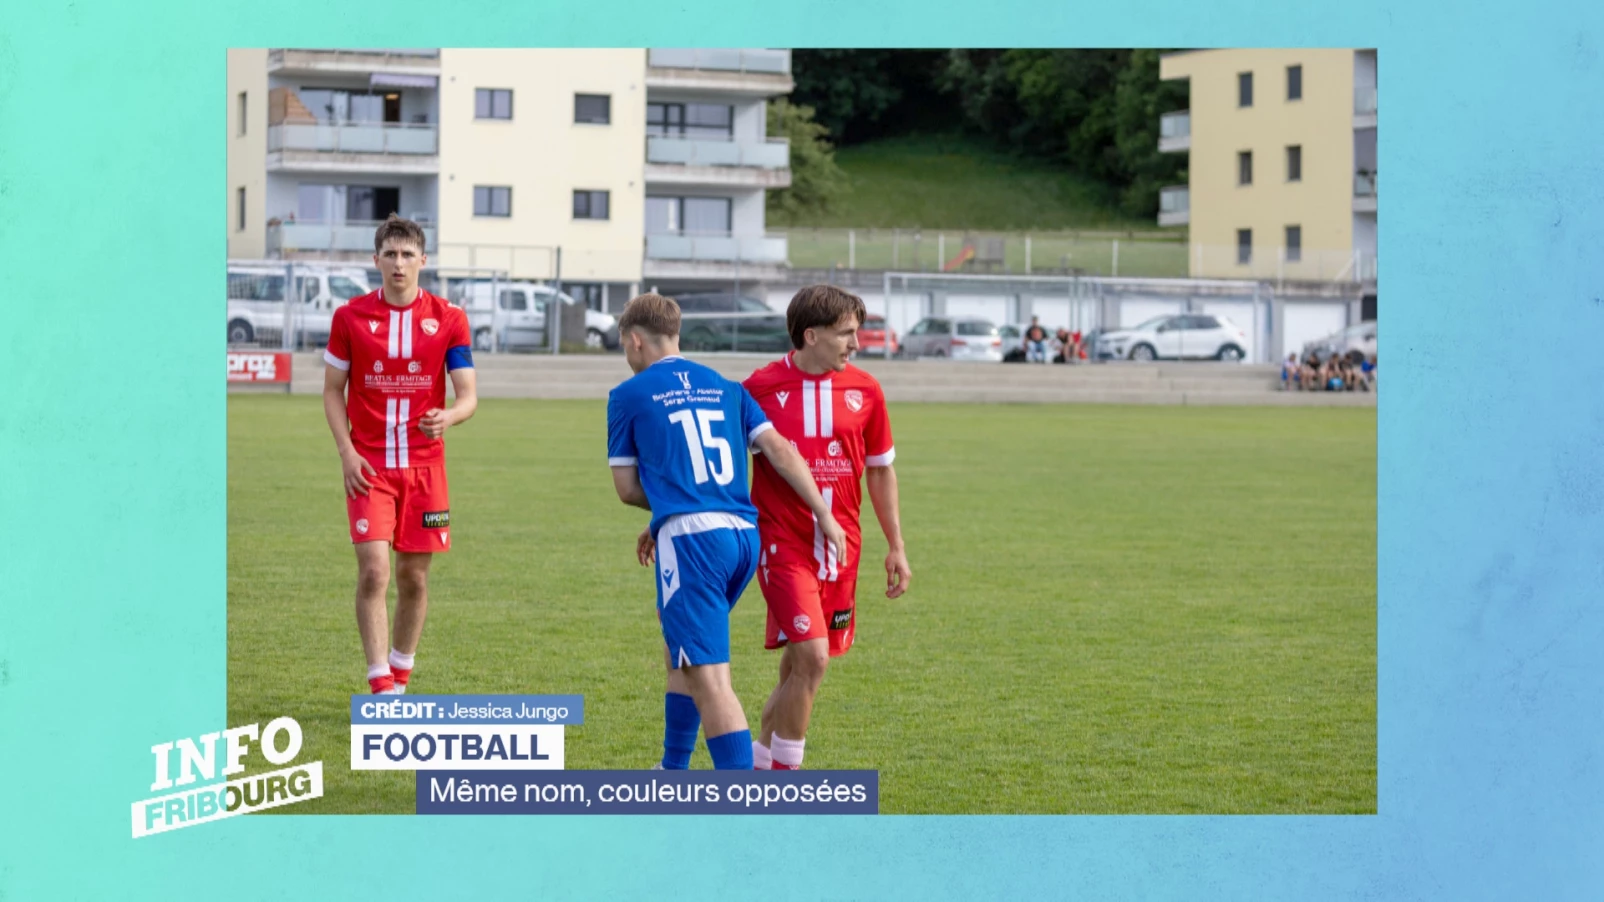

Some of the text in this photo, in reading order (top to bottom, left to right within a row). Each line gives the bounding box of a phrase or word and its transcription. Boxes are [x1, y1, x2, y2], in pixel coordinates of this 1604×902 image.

[364, 373, 432, 382] BEATUS ERMITAGE
[667, 408, 734, 487] 15
